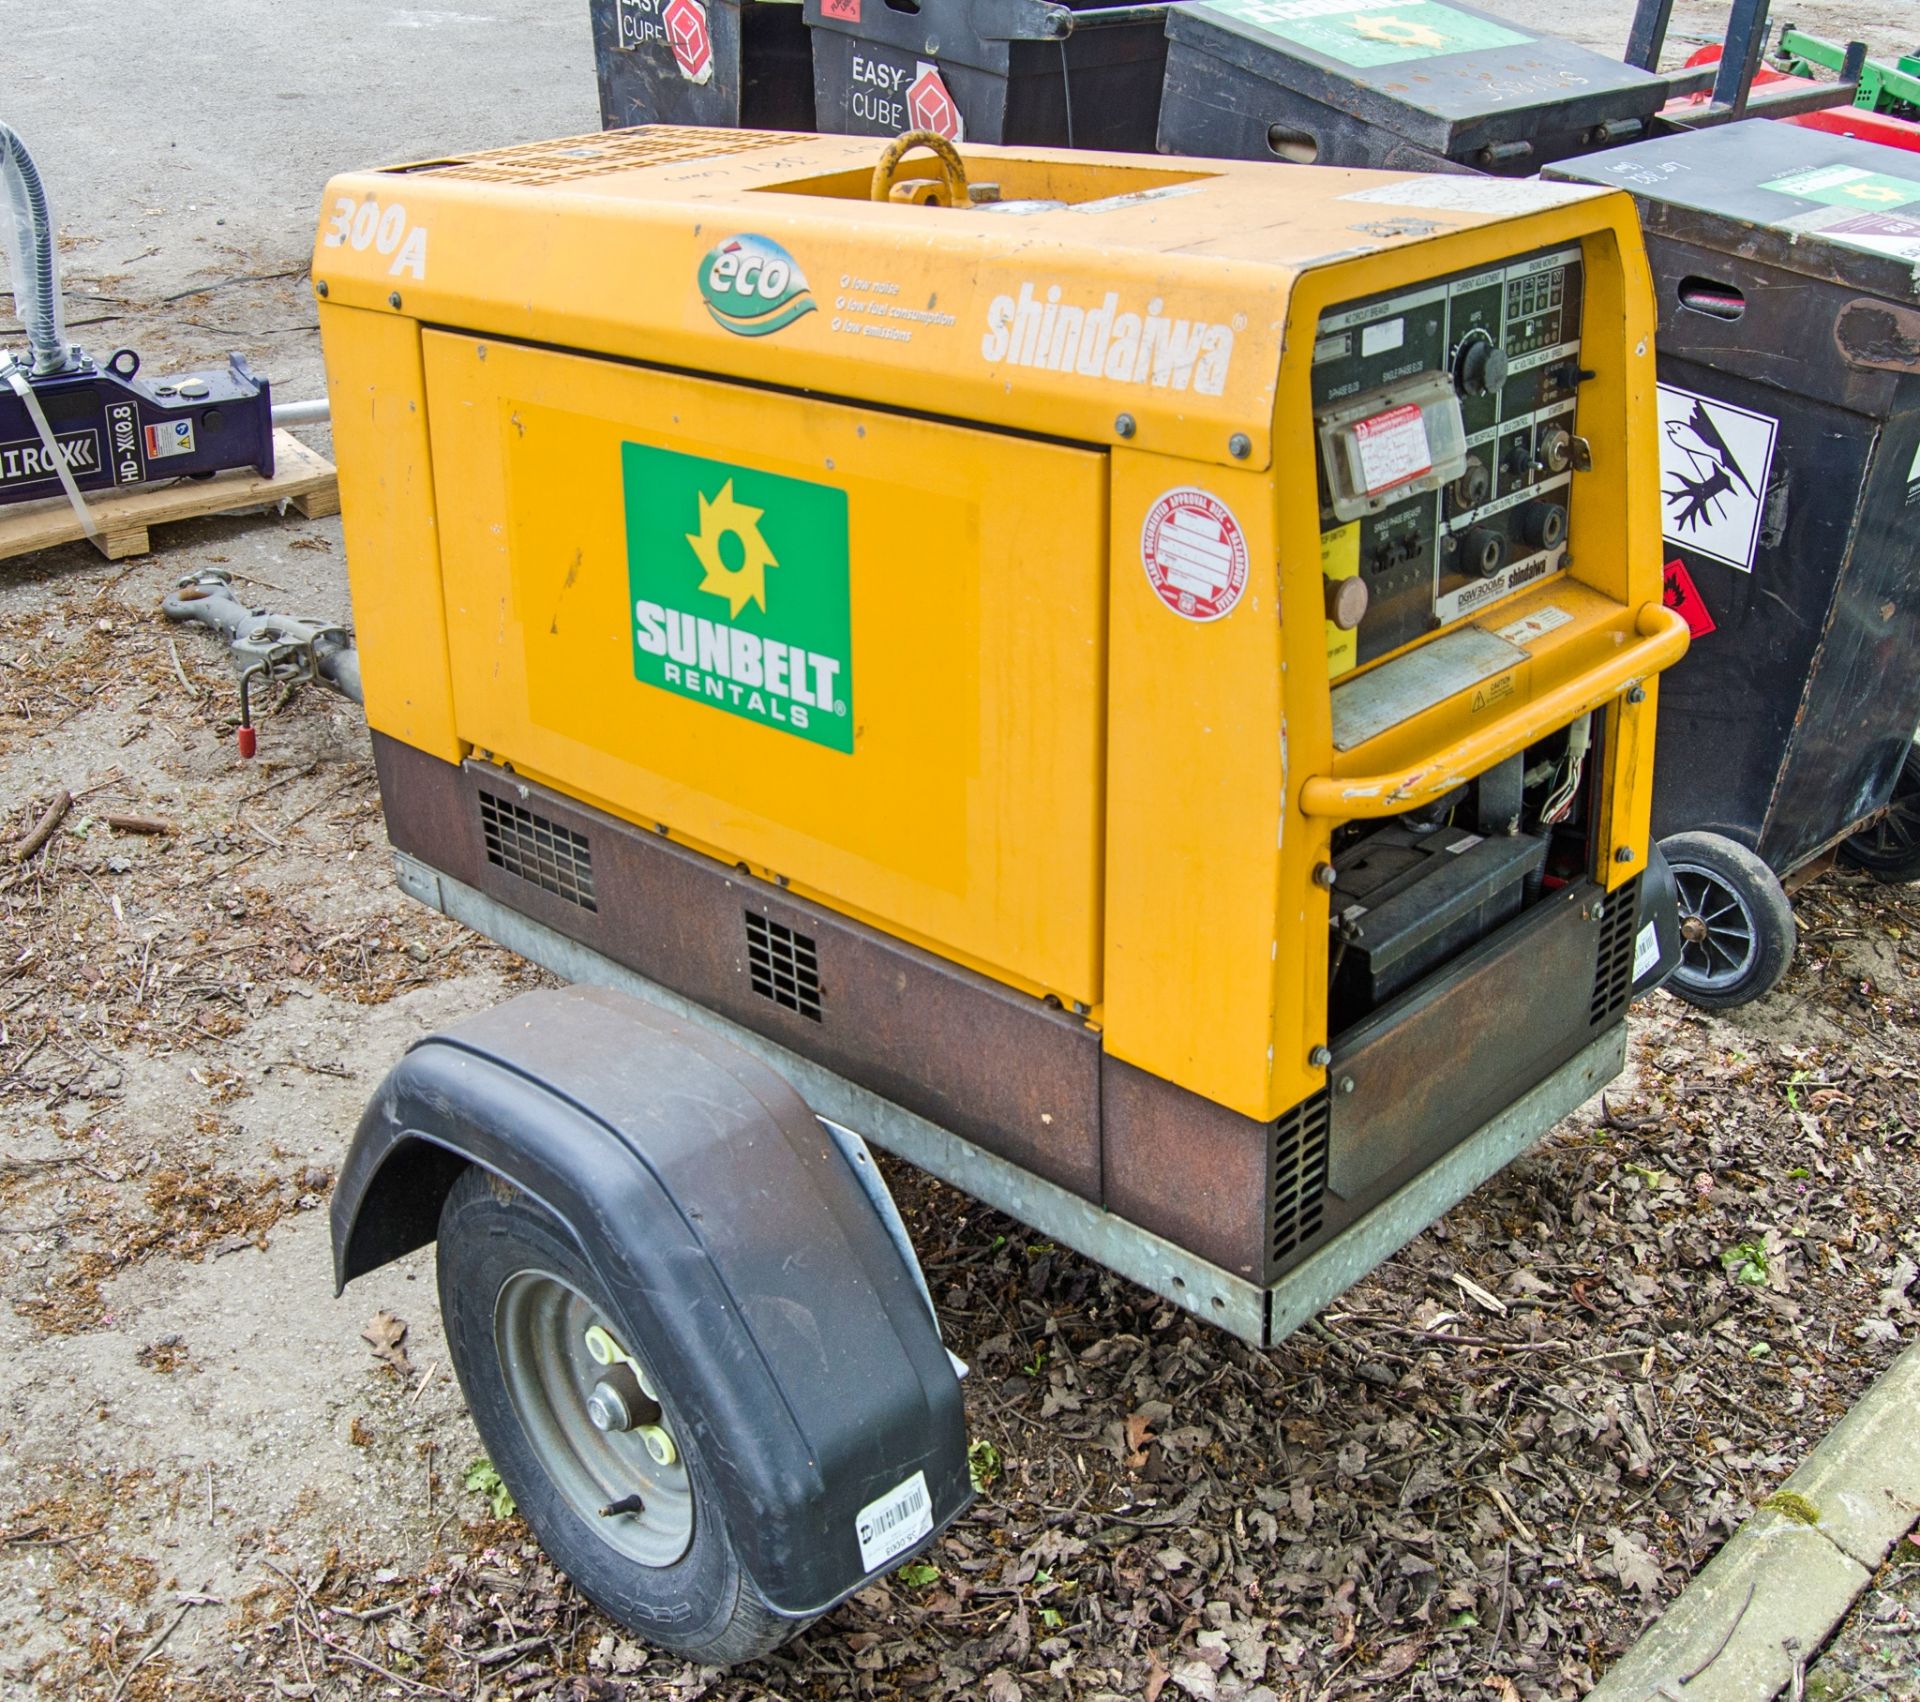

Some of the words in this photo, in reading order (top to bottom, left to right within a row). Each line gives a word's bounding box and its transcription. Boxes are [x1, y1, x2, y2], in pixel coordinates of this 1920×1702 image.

[852, 56, 902, 91] EASY
[852, 92, 903, 128] CUBE
[324, 197, 427, 280] 300A
[852, 277, 870, 291] low
[873, 281, 900, 295] noise
[847, 297, 865, 312] low
[868, 301, 888, 316] fuel
[890, 306, 956, 327] consumption
[843, 319, 861, 334] low
[863, 325, 912, 343] emissions
[1169, 492, 1207, 508] APPROVAL
[1508, 558, 1546, 589] shindaiwa
[635, 599, 841, 713] SUNBELT
[664, 661, 809, 729] RENTALS
